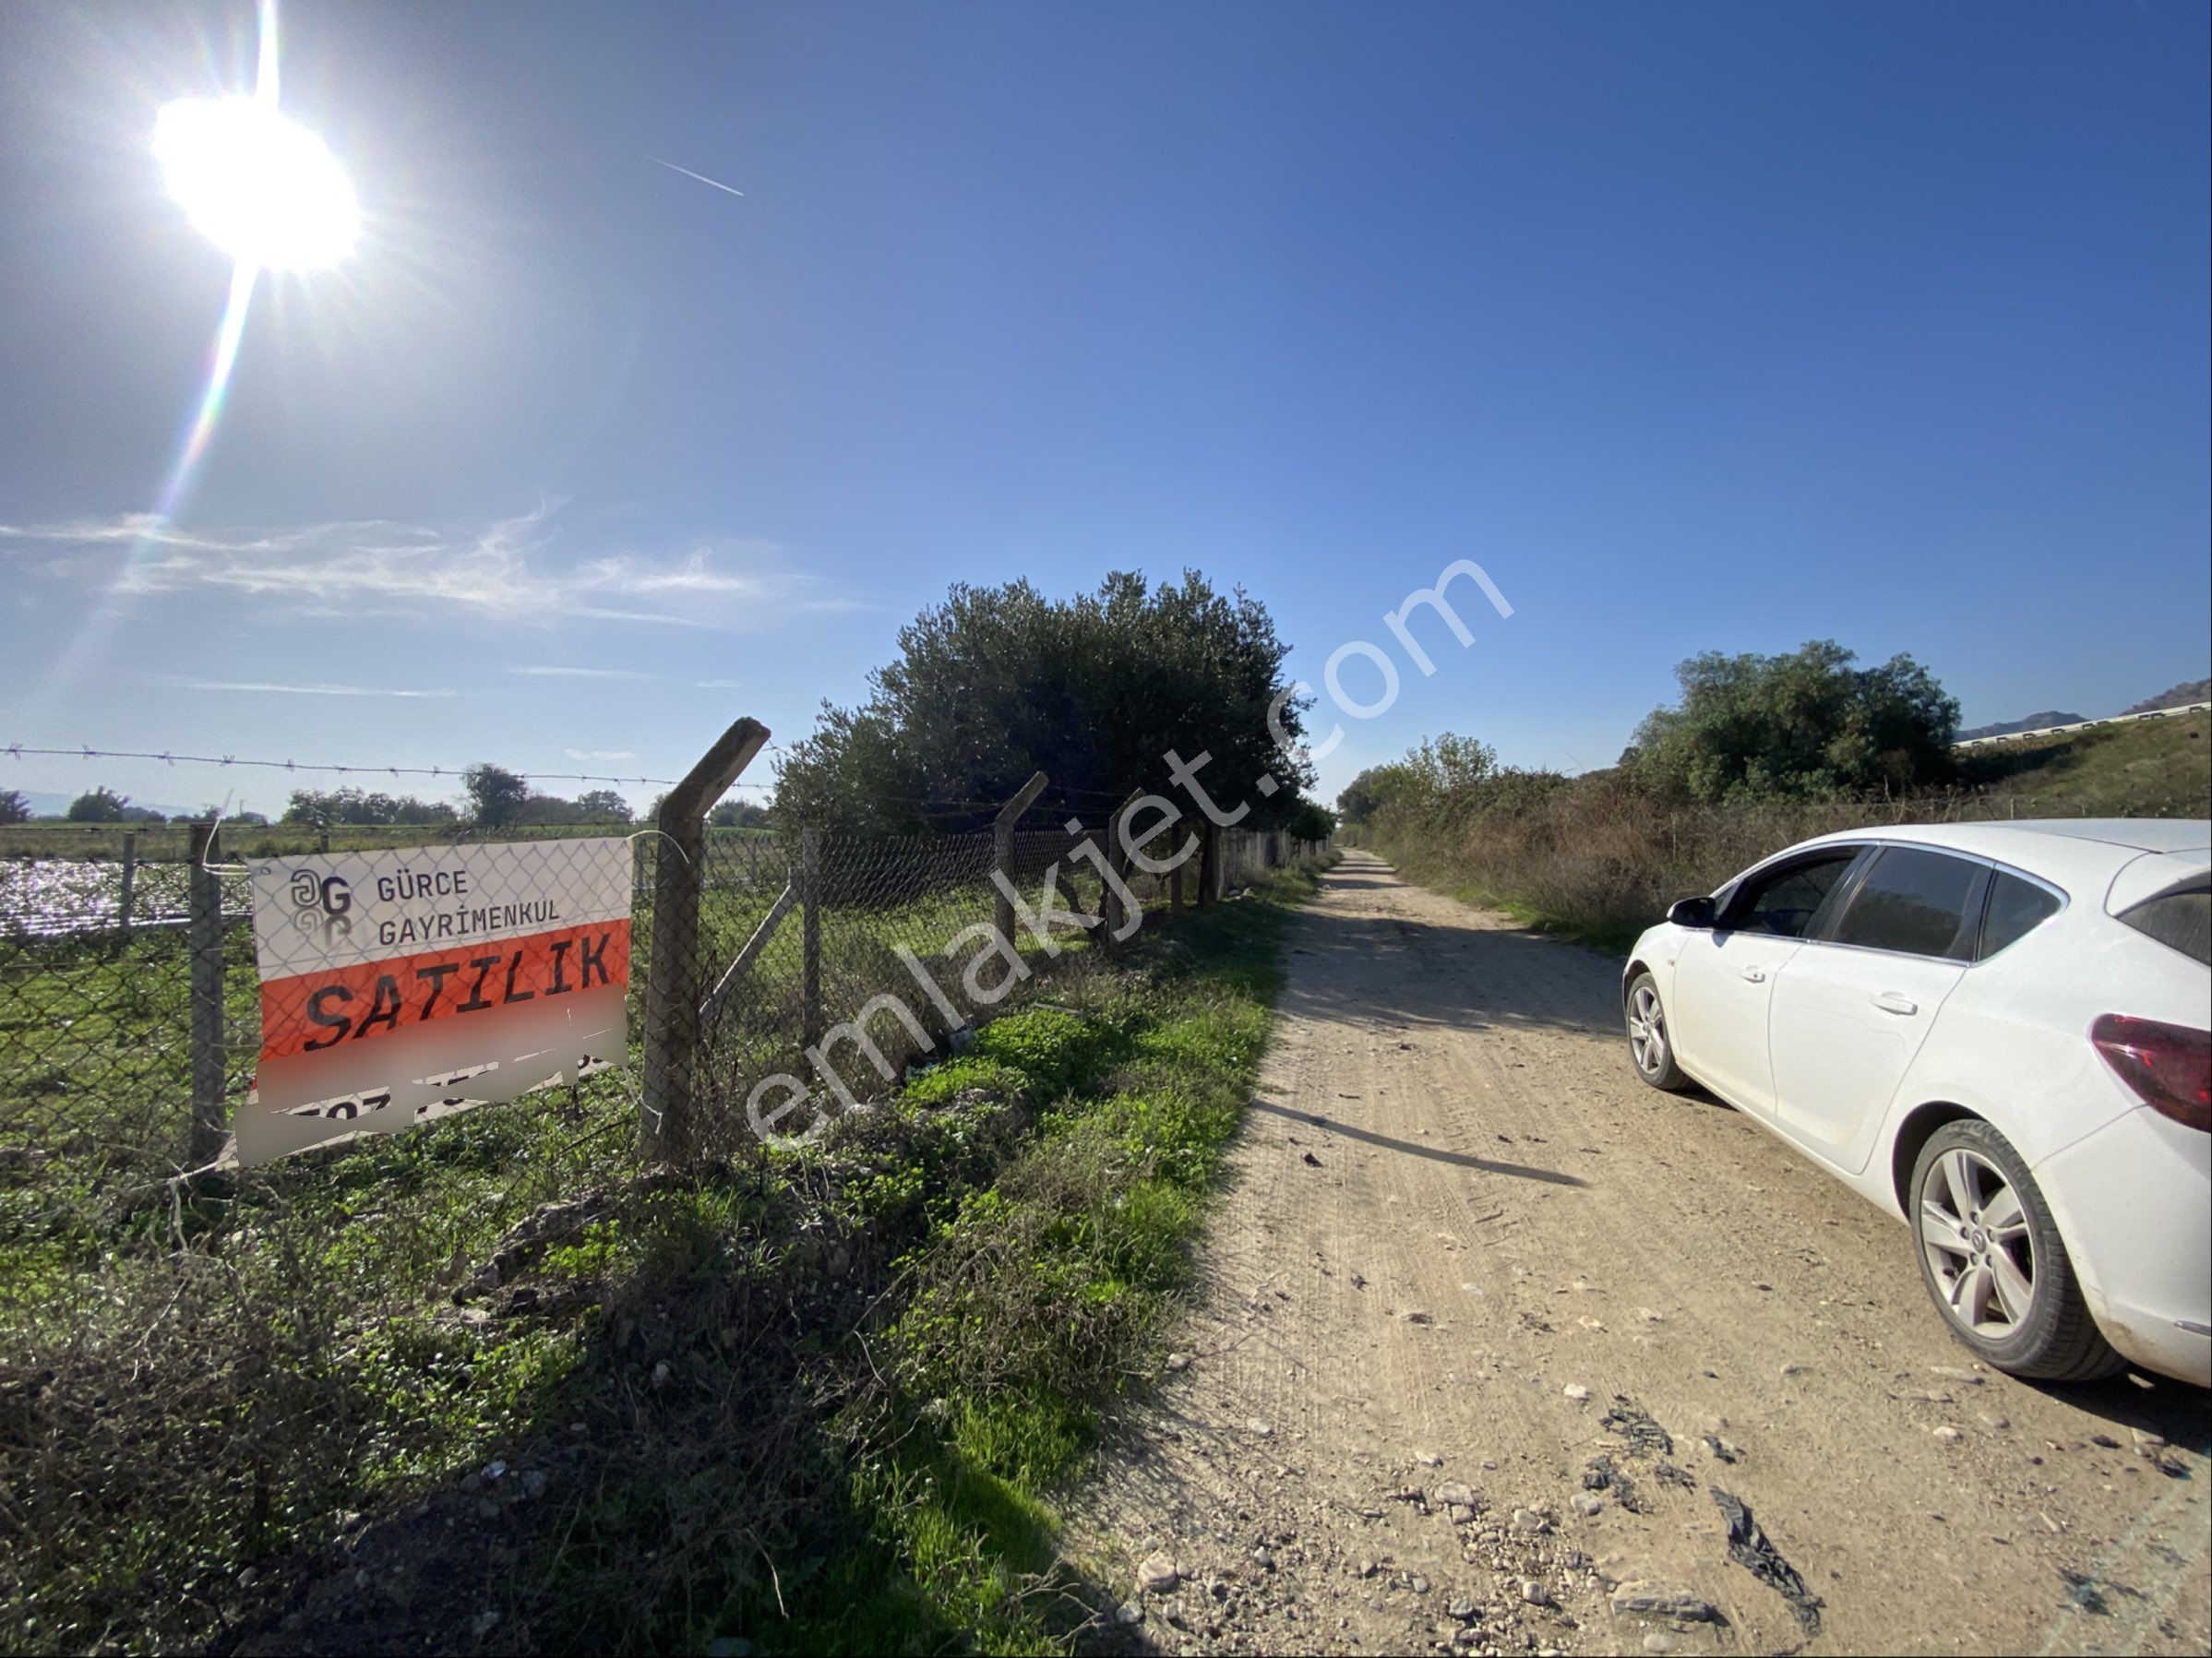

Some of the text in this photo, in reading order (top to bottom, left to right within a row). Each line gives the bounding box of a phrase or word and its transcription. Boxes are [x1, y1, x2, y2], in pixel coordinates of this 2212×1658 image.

[377, 869, 469, 902] GÜRCE
[379, 900, 559, 946] GAYRİMENKUL
[304, 933, 611, 1052] SATILIK
